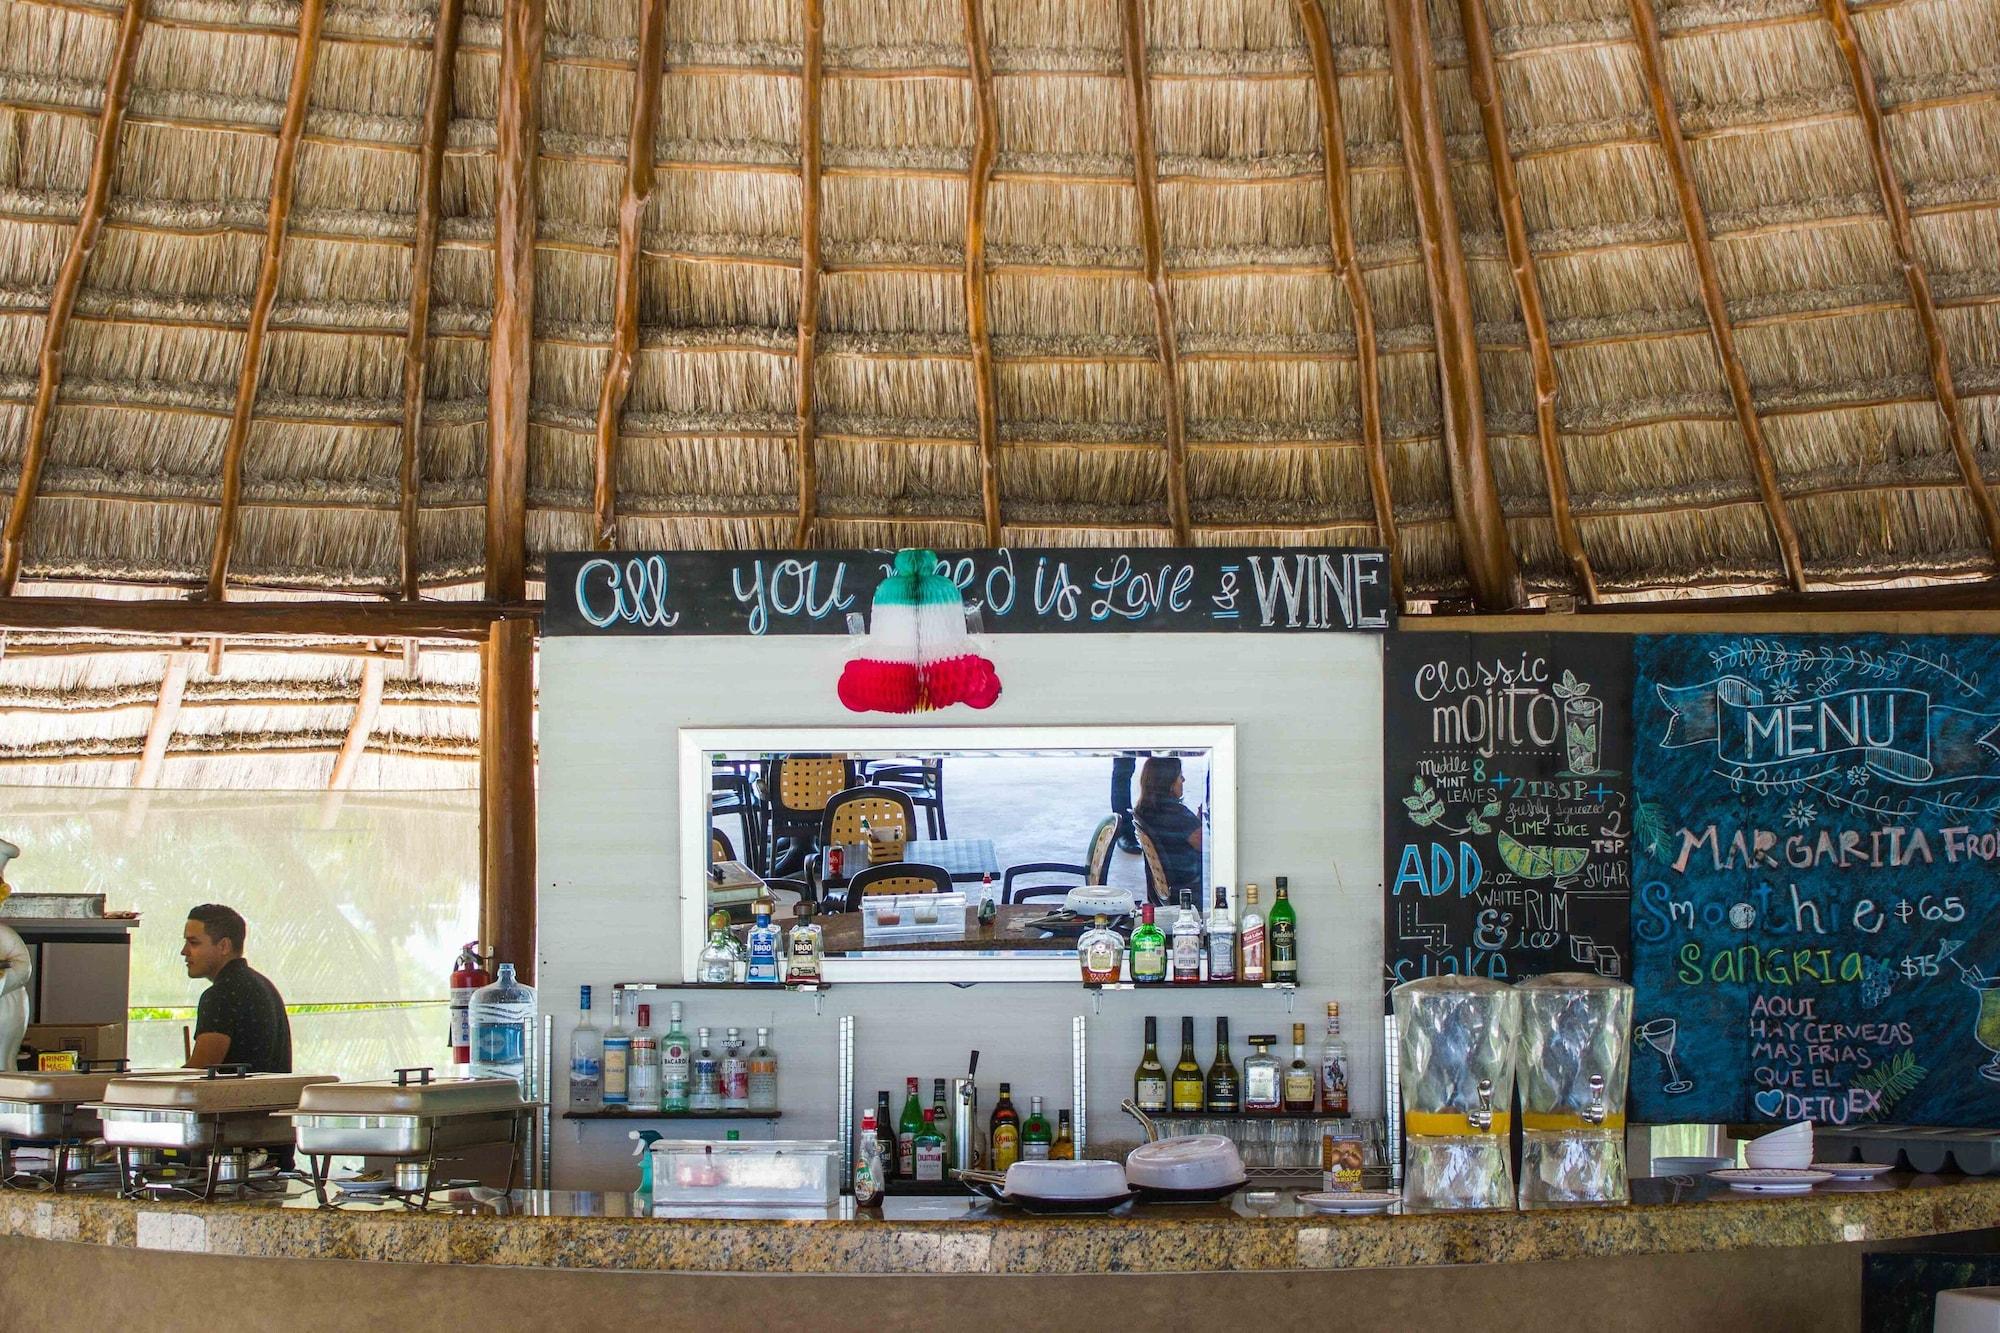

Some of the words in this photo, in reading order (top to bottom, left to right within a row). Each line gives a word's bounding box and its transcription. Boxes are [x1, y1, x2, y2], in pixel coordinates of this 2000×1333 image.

[575, 554, 680, 628] All
[732, 559, 856, 636] you
[1033, 556, 1082, 622] is
[1090, 554, 1195, 621] Love
[1211, 571, 1240, 610] &
[1248, 553, 1390, 629] WINE
[1414, 651, 1549, 702] Classic
[1745, 693, 1895, 759] MENU
[1436, 775, 1468, 789] MINT
[1473, 758, 1487, 783] 8
[1447, 787, 1498, 803] LEAVES
[1513, 821, 1547, 836] LIME
[1553, 823, 1590, 836] JUICE
[1600, 810, 1631, 839] 2
[1591, 839, 1630, 855] TSP.
[1670, 824, 1934, 875] MARGARITA
[1392, 841, 1484, 899] ADD
[1583, 861, 1631, 889] SUGAR
[1475, 889, 1524, 907] WHITE
[1524, 888, 1569, 933] RUM
[1894, 894, 1967, 925] $65
[1473, 908, 1514, 951] &
[753, 944, 772, 952] 1800
[794, 943, 812, 952] 1800
[1900, 954, 1940, 978] $75
[1751, 995, 1817, 1020] AQUI
[1749, 1018, 1801, 1041] HAY
[1803, 1022, 1914, 1046] CERVEZAS
[1751, 1043, 1802, 1067] MAS
[1807, 1044, 1872, 1069] FRIAS
[1754, 1066, 1807, 1088] QUE
[1812, 1068, 1842, 1088] EL
